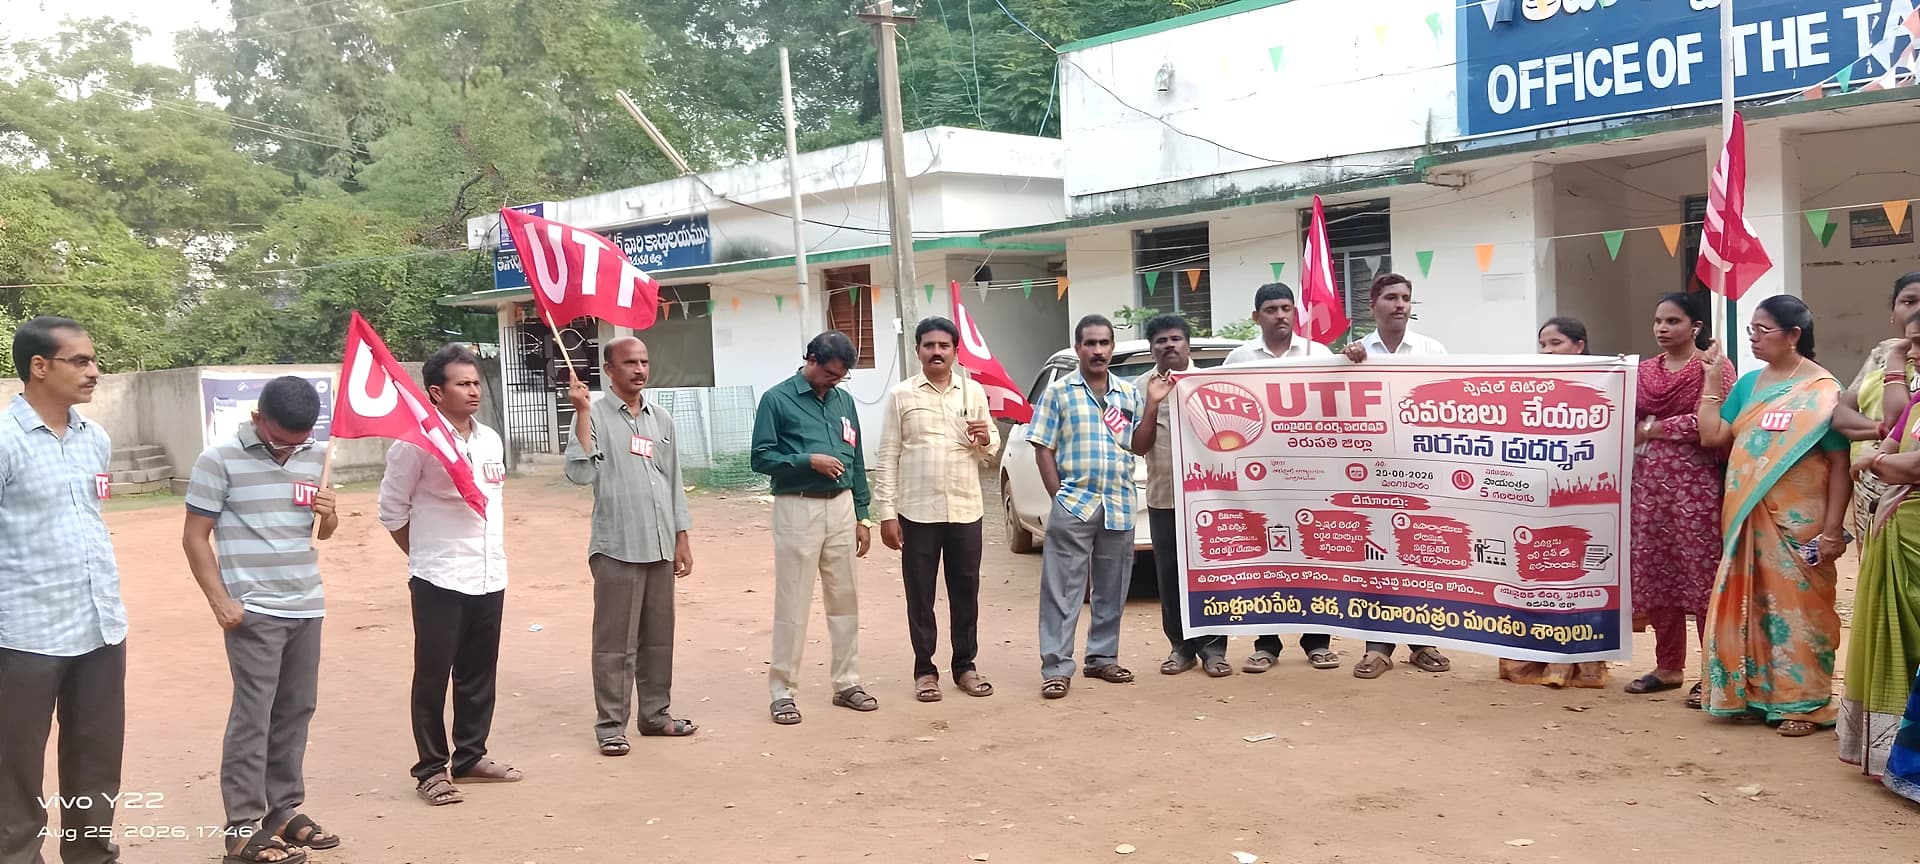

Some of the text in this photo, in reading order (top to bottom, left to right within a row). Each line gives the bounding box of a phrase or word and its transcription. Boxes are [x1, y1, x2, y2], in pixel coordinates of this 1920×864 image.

[1487, 41, 1644, 114] OFFICE
[1647, 32, 1704, 89] OF
[1721, 11, 1831, 76] THE
[1205, 393, 1254, 414] UTF
[1266, 381, 1382, 418] UTF
[1398, 396, 1611, 430] సవరణలు చేయాలి
[1761, 412, 1793, 428] UTF
[1287, 436, 1372, 452] తిరుపతి జిల్లా
[1412, 434, 1595, 471] నిరసన ప్రదర్శన
[1480, 487, 1489, 498] 5
[1203, 591, 1604, 645] సూళ్లూరుపేట, తడ, దొరవారిసత్రం మండల శాఖలు..
